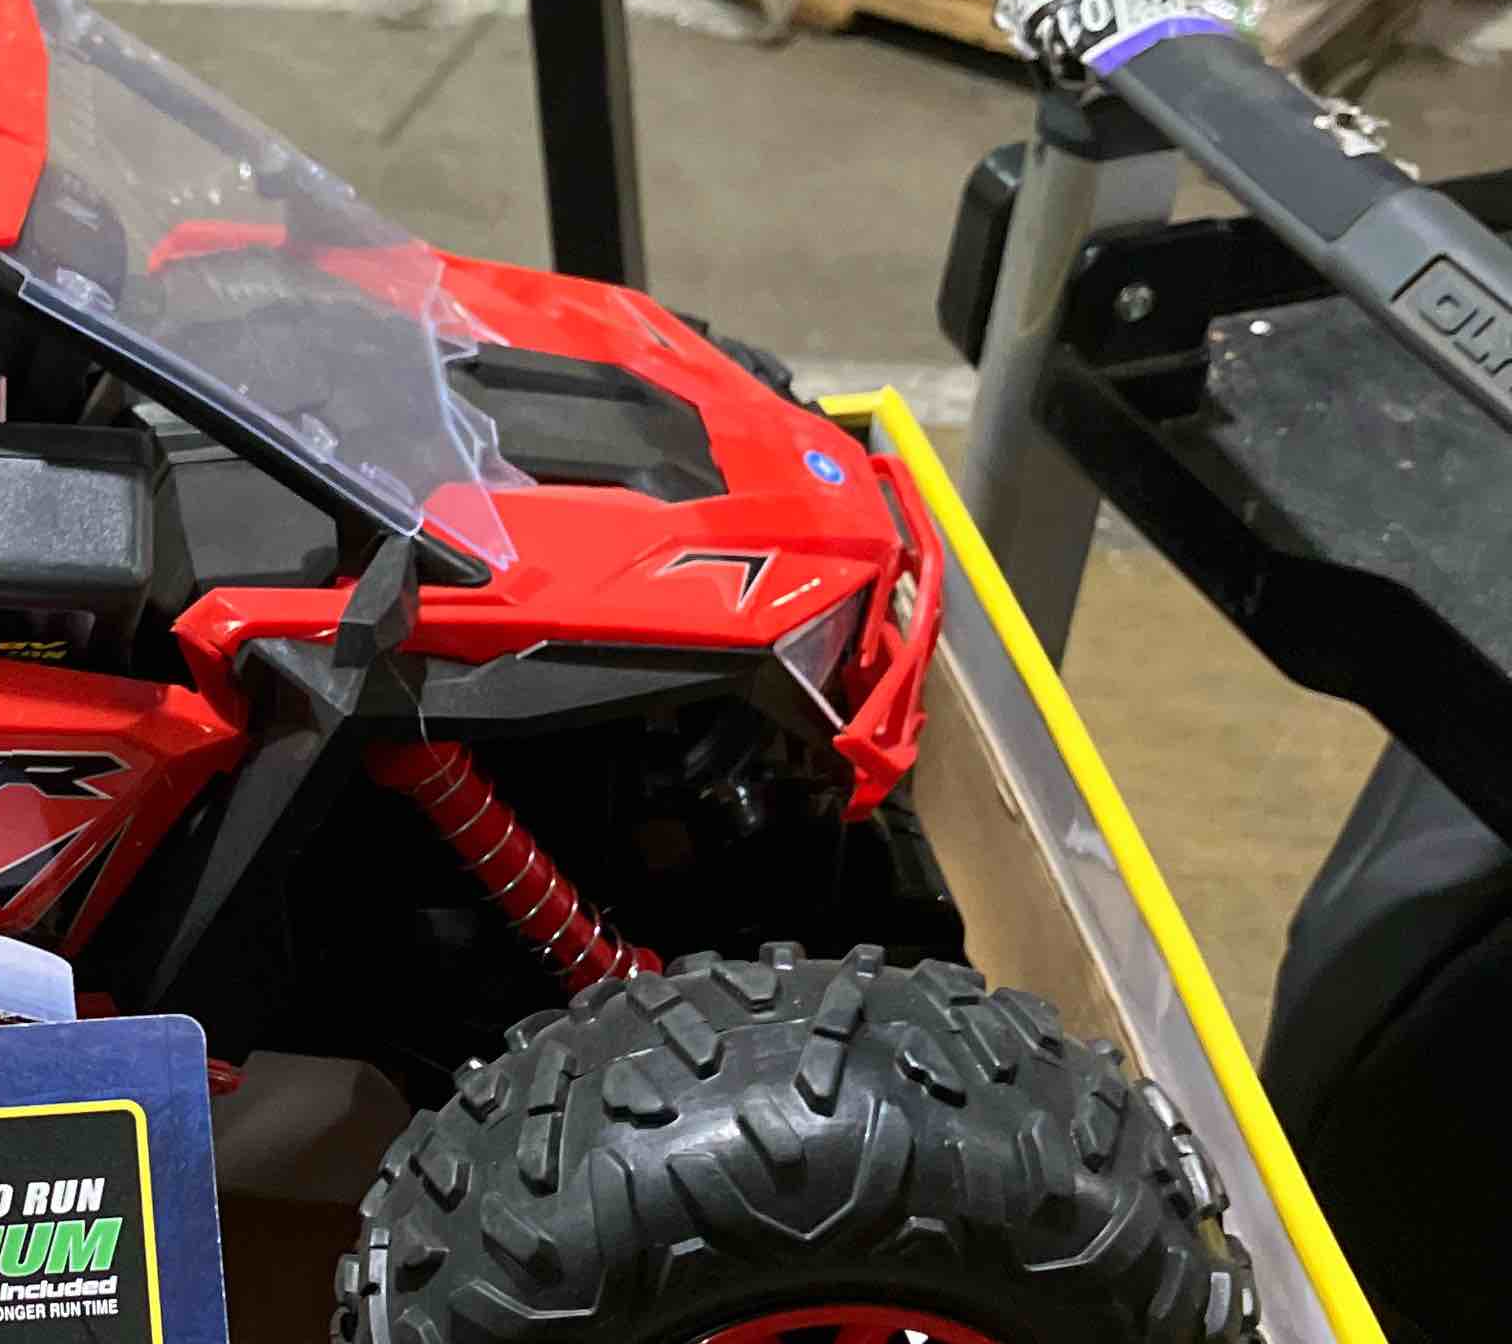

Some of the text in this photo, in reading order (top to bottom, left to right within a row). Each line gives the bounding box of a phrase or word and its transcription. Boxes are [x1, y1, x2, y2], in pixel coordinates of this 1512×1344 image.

[22, 1177, 106, 1216] RUN
[0, 1275, 118, 1302] Included
[50, 1301, 82, 1319] RUN
[81, 1298, 119, 1316] TIME
